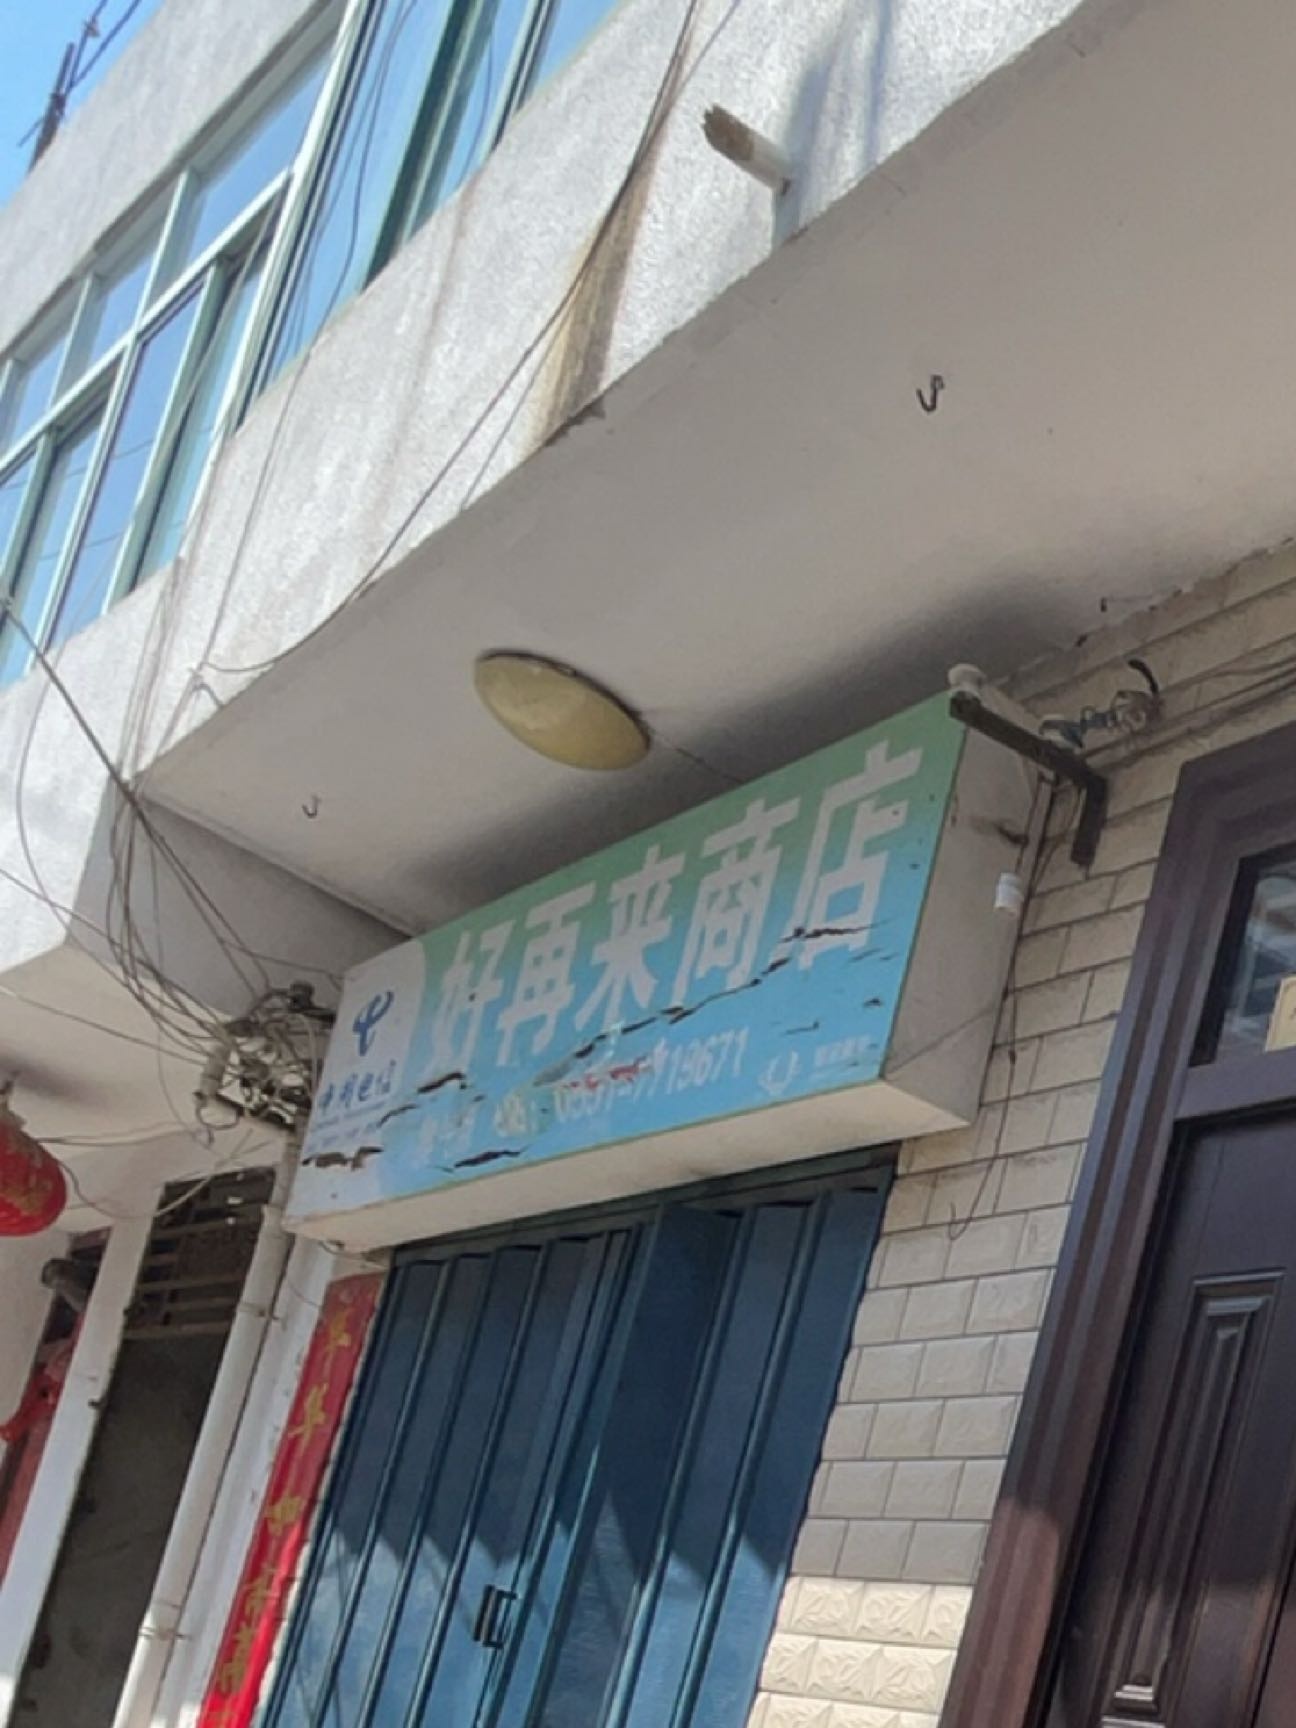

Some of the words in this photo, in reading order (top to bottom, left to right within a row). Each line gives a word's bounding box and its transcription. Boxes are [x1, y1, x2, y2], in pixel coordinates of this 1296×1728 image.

[420, 739, 922, 1078] 好再来商店
